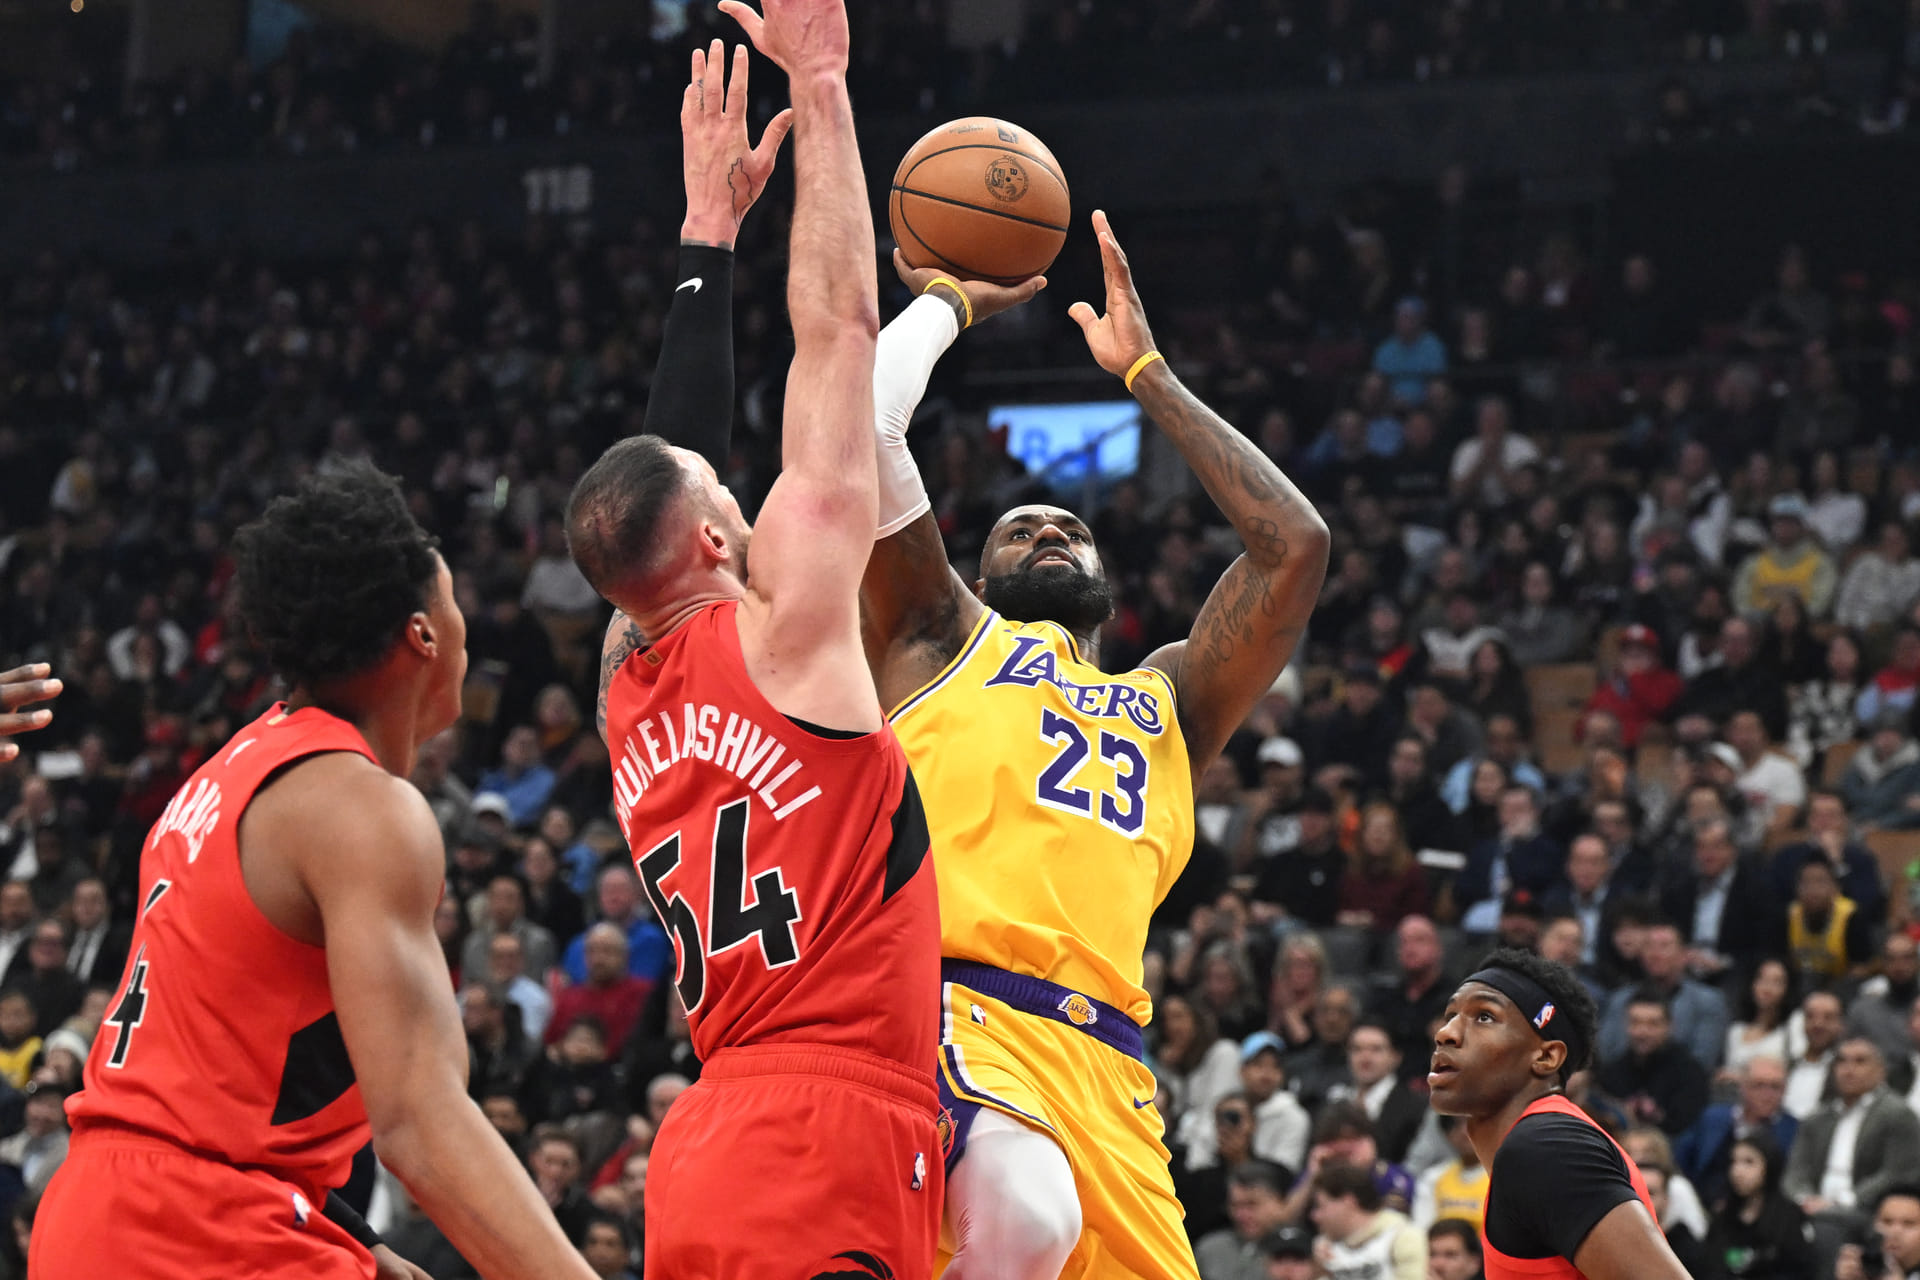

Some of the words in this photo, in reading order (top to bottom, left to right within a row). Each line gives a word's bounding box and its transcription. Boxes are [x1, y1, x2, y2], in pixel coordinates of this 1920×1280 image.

[982, 636, 1164, 735] LAKERS
[615, 703, 822, 850] MUKELASHVILI
[1036, 705, 1149, 840] 23
[104, 879, 173, 1069] 4
[635, 794, 802, 1018] 54
